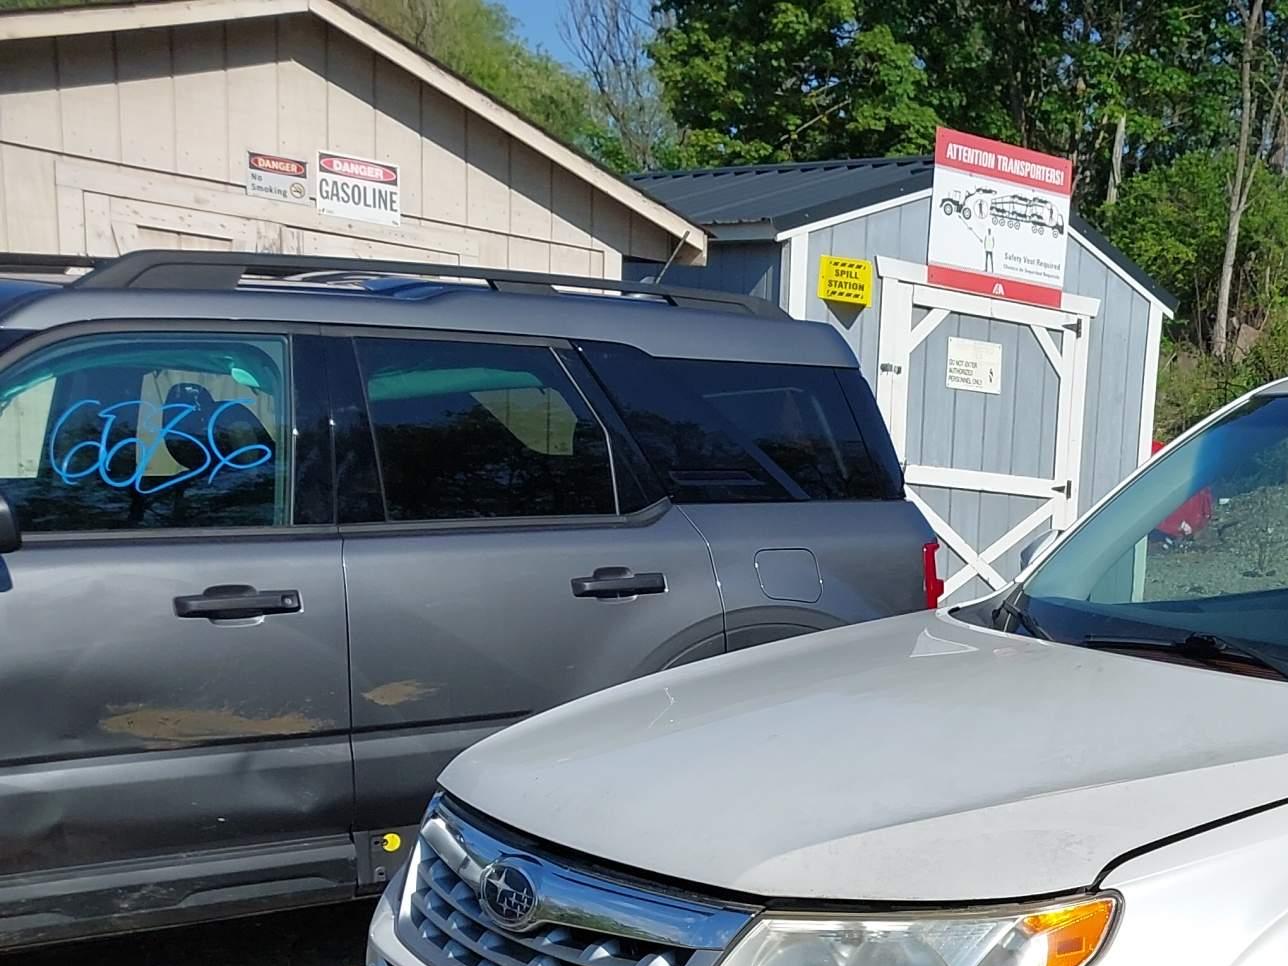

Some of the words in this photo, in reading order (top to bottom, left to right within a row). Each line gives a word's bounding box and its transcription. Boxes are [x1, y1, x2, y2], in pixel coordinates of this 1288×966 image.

[257, 157, 297, 173] DANGER
[333, 159, 384, 179] DANGER
[946, 142, 995, 169] ATTENTION
[997, 155, 1065, 186] TRANSPORTERS!
[251, 173, 263, 181] No
[251, 183, 288, 198] Smoking
[319, 178, 398, 212] GASOLINE
[834, 269, 860, 279] SPILL
[827, 280, 865, 291] STATION
